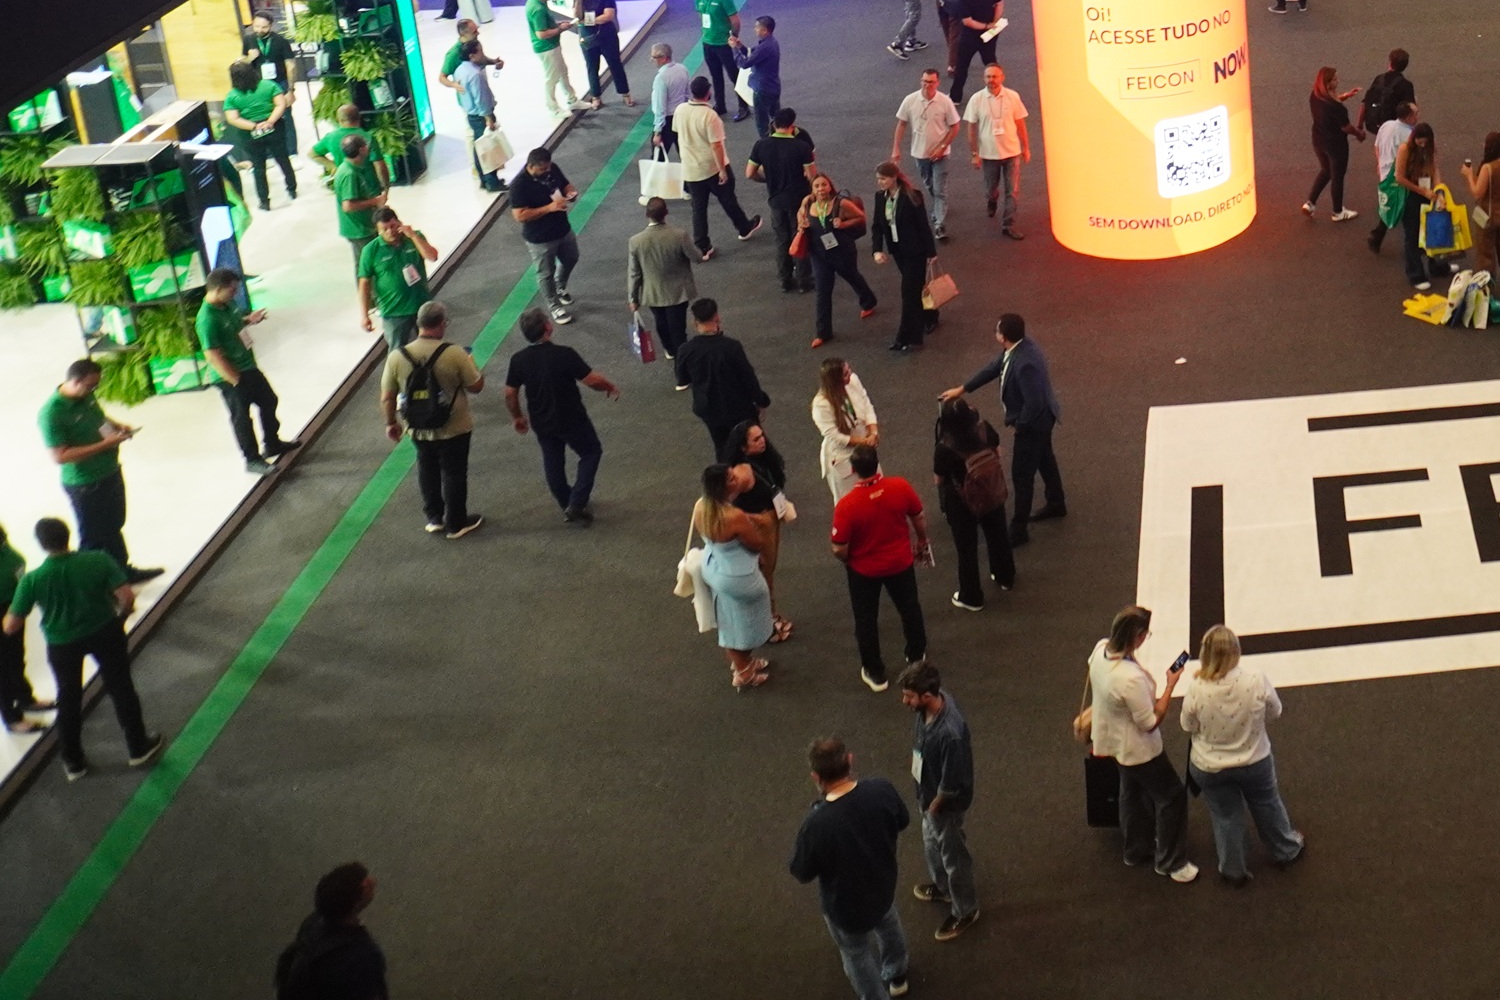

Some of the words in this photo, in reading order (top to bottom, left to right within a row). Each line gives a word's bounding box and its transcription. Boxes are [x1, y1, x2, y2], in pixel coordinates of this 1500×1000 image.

[1086, 6, 1111, 23] Oi!
[1089, 28, 1155, 45] ACESSE
[1161, 19, 1210, 42] TUDO
[1213, 9, 1231, 30] NO
[1126, 70, 1195, 92] FEICON
[1089, 216, 1115, 229] SEM
[1208, 196, 1243, 220] DIRETO
